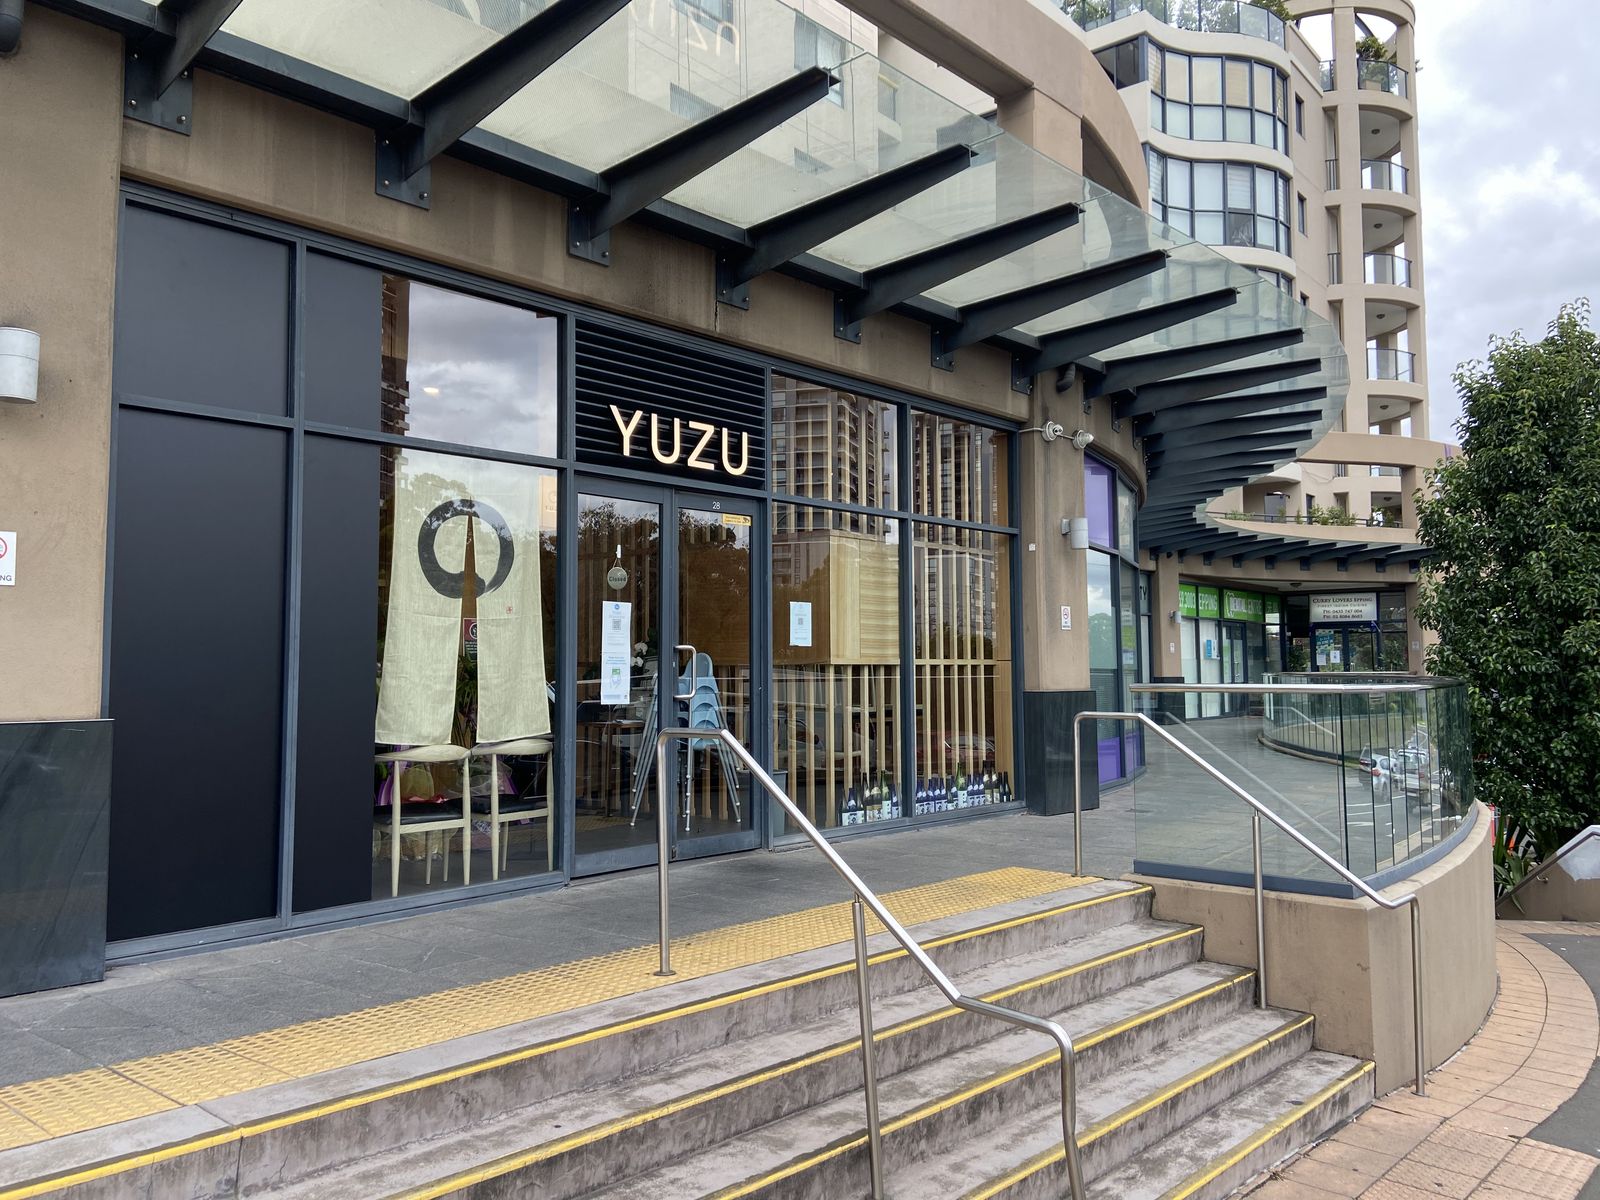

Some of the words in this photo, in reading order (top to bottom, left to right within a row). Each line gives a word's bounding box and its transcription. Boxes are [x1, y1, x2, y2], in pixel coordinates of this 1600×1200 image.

[609, 404, 748, 476] YUZU
[712, 501, 720, 509] 28
[1199, 593, 1217, 610] EPPING
